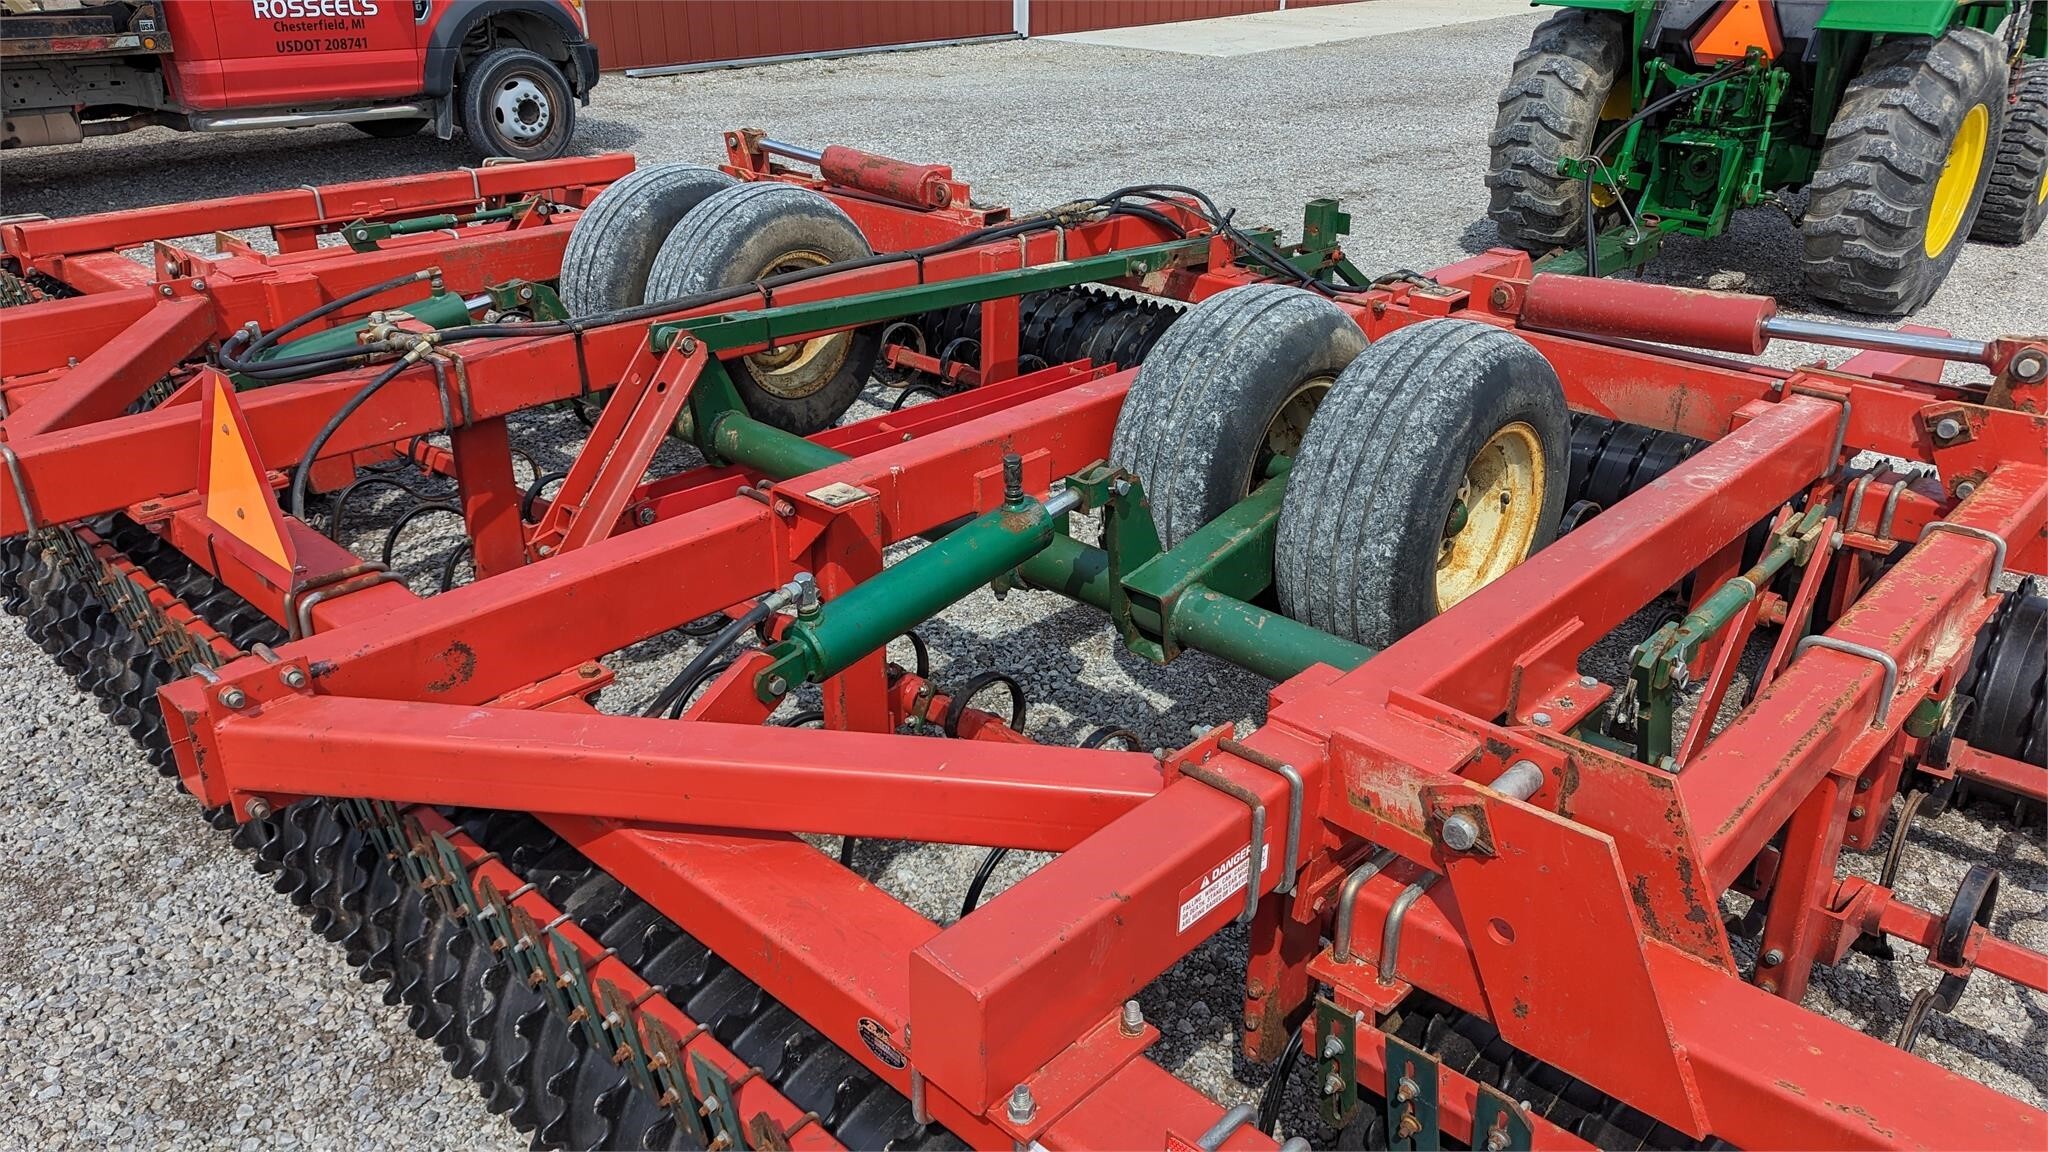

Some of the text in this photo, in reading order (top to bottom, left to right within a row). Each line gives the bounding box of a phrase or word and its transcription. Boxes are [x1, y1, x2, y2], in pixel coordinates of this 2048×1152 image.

[140, 23, 154, 31] USA
[273, 19, 365, 32] Chesterfield, MI
[276, 37, 368, 53] USDOT 208741
[1222, 873, 1232, 884] CAN
